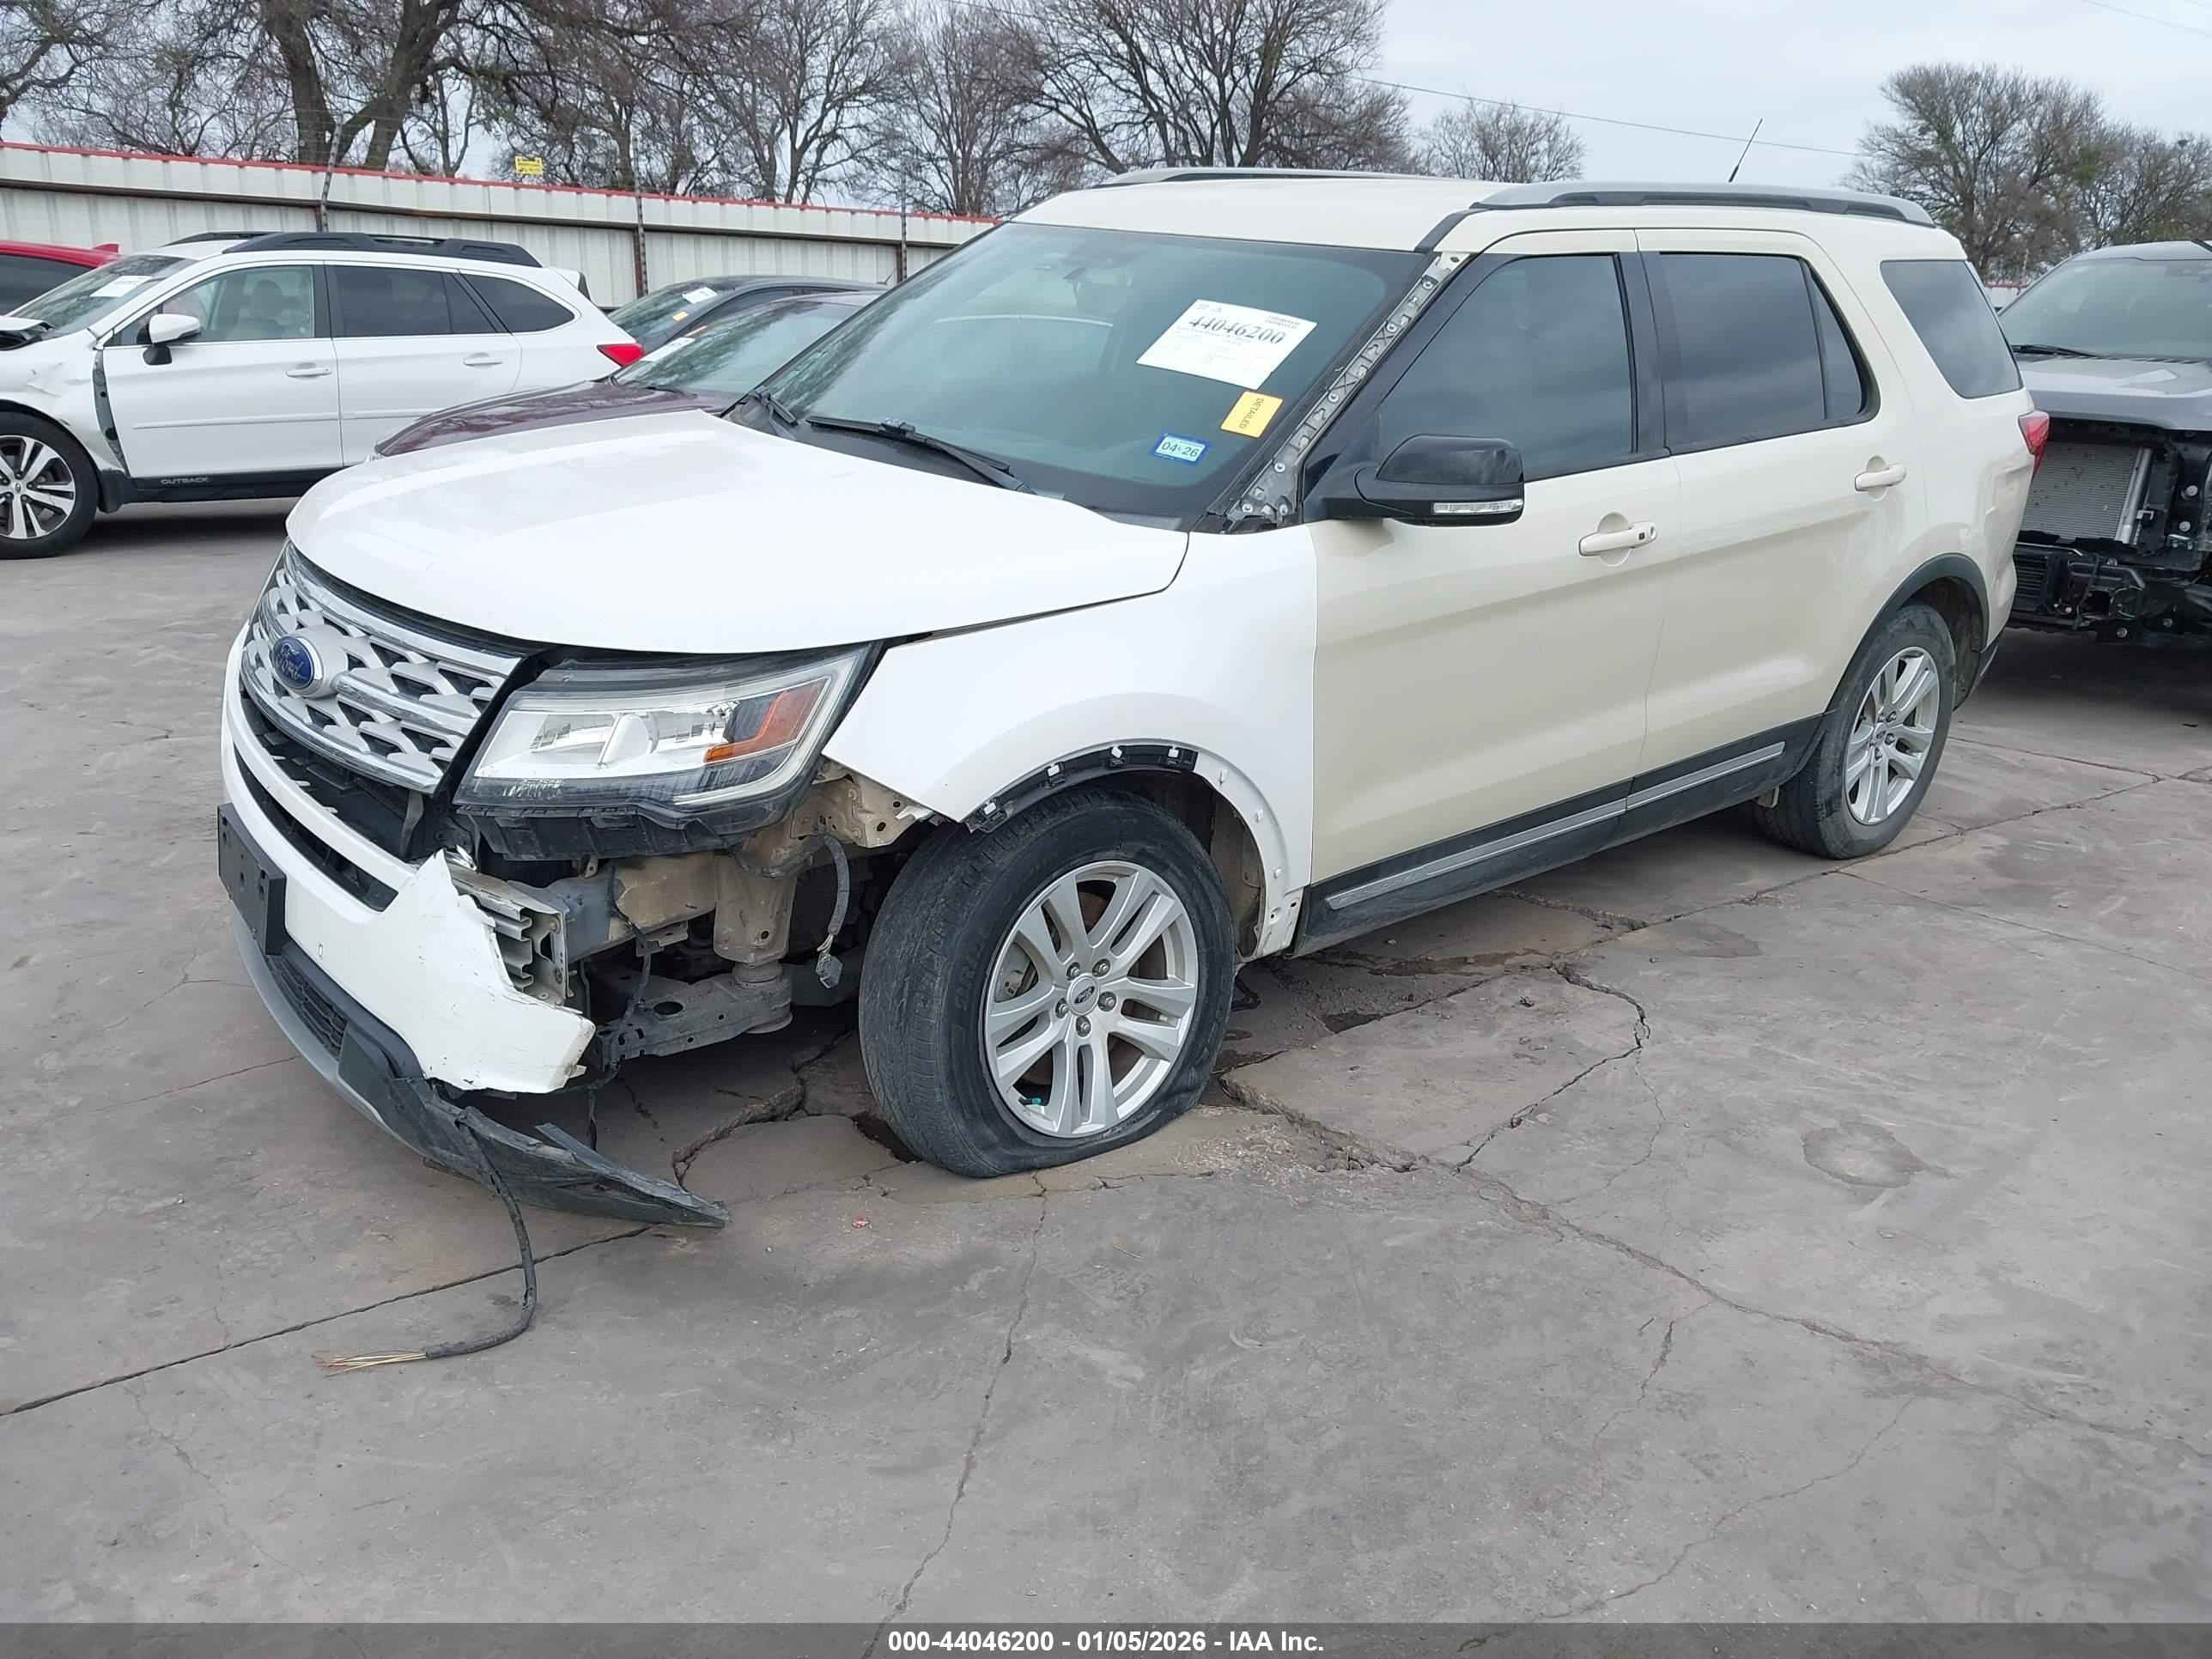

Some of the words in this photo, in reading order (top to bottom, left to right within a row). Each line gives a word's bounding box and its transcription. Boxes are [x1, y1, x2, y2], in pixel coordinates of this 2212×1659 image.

[1189, 315, 1286, 344] 44046200
[1238, 398, 1265, 429] DETAILED
[1161, 441, 1178, 453] 04
[1182, 447, 1200, 458] 26
[161, 477, 210, 485] OUTBACK
[275, 642, 309, 681] Ford
